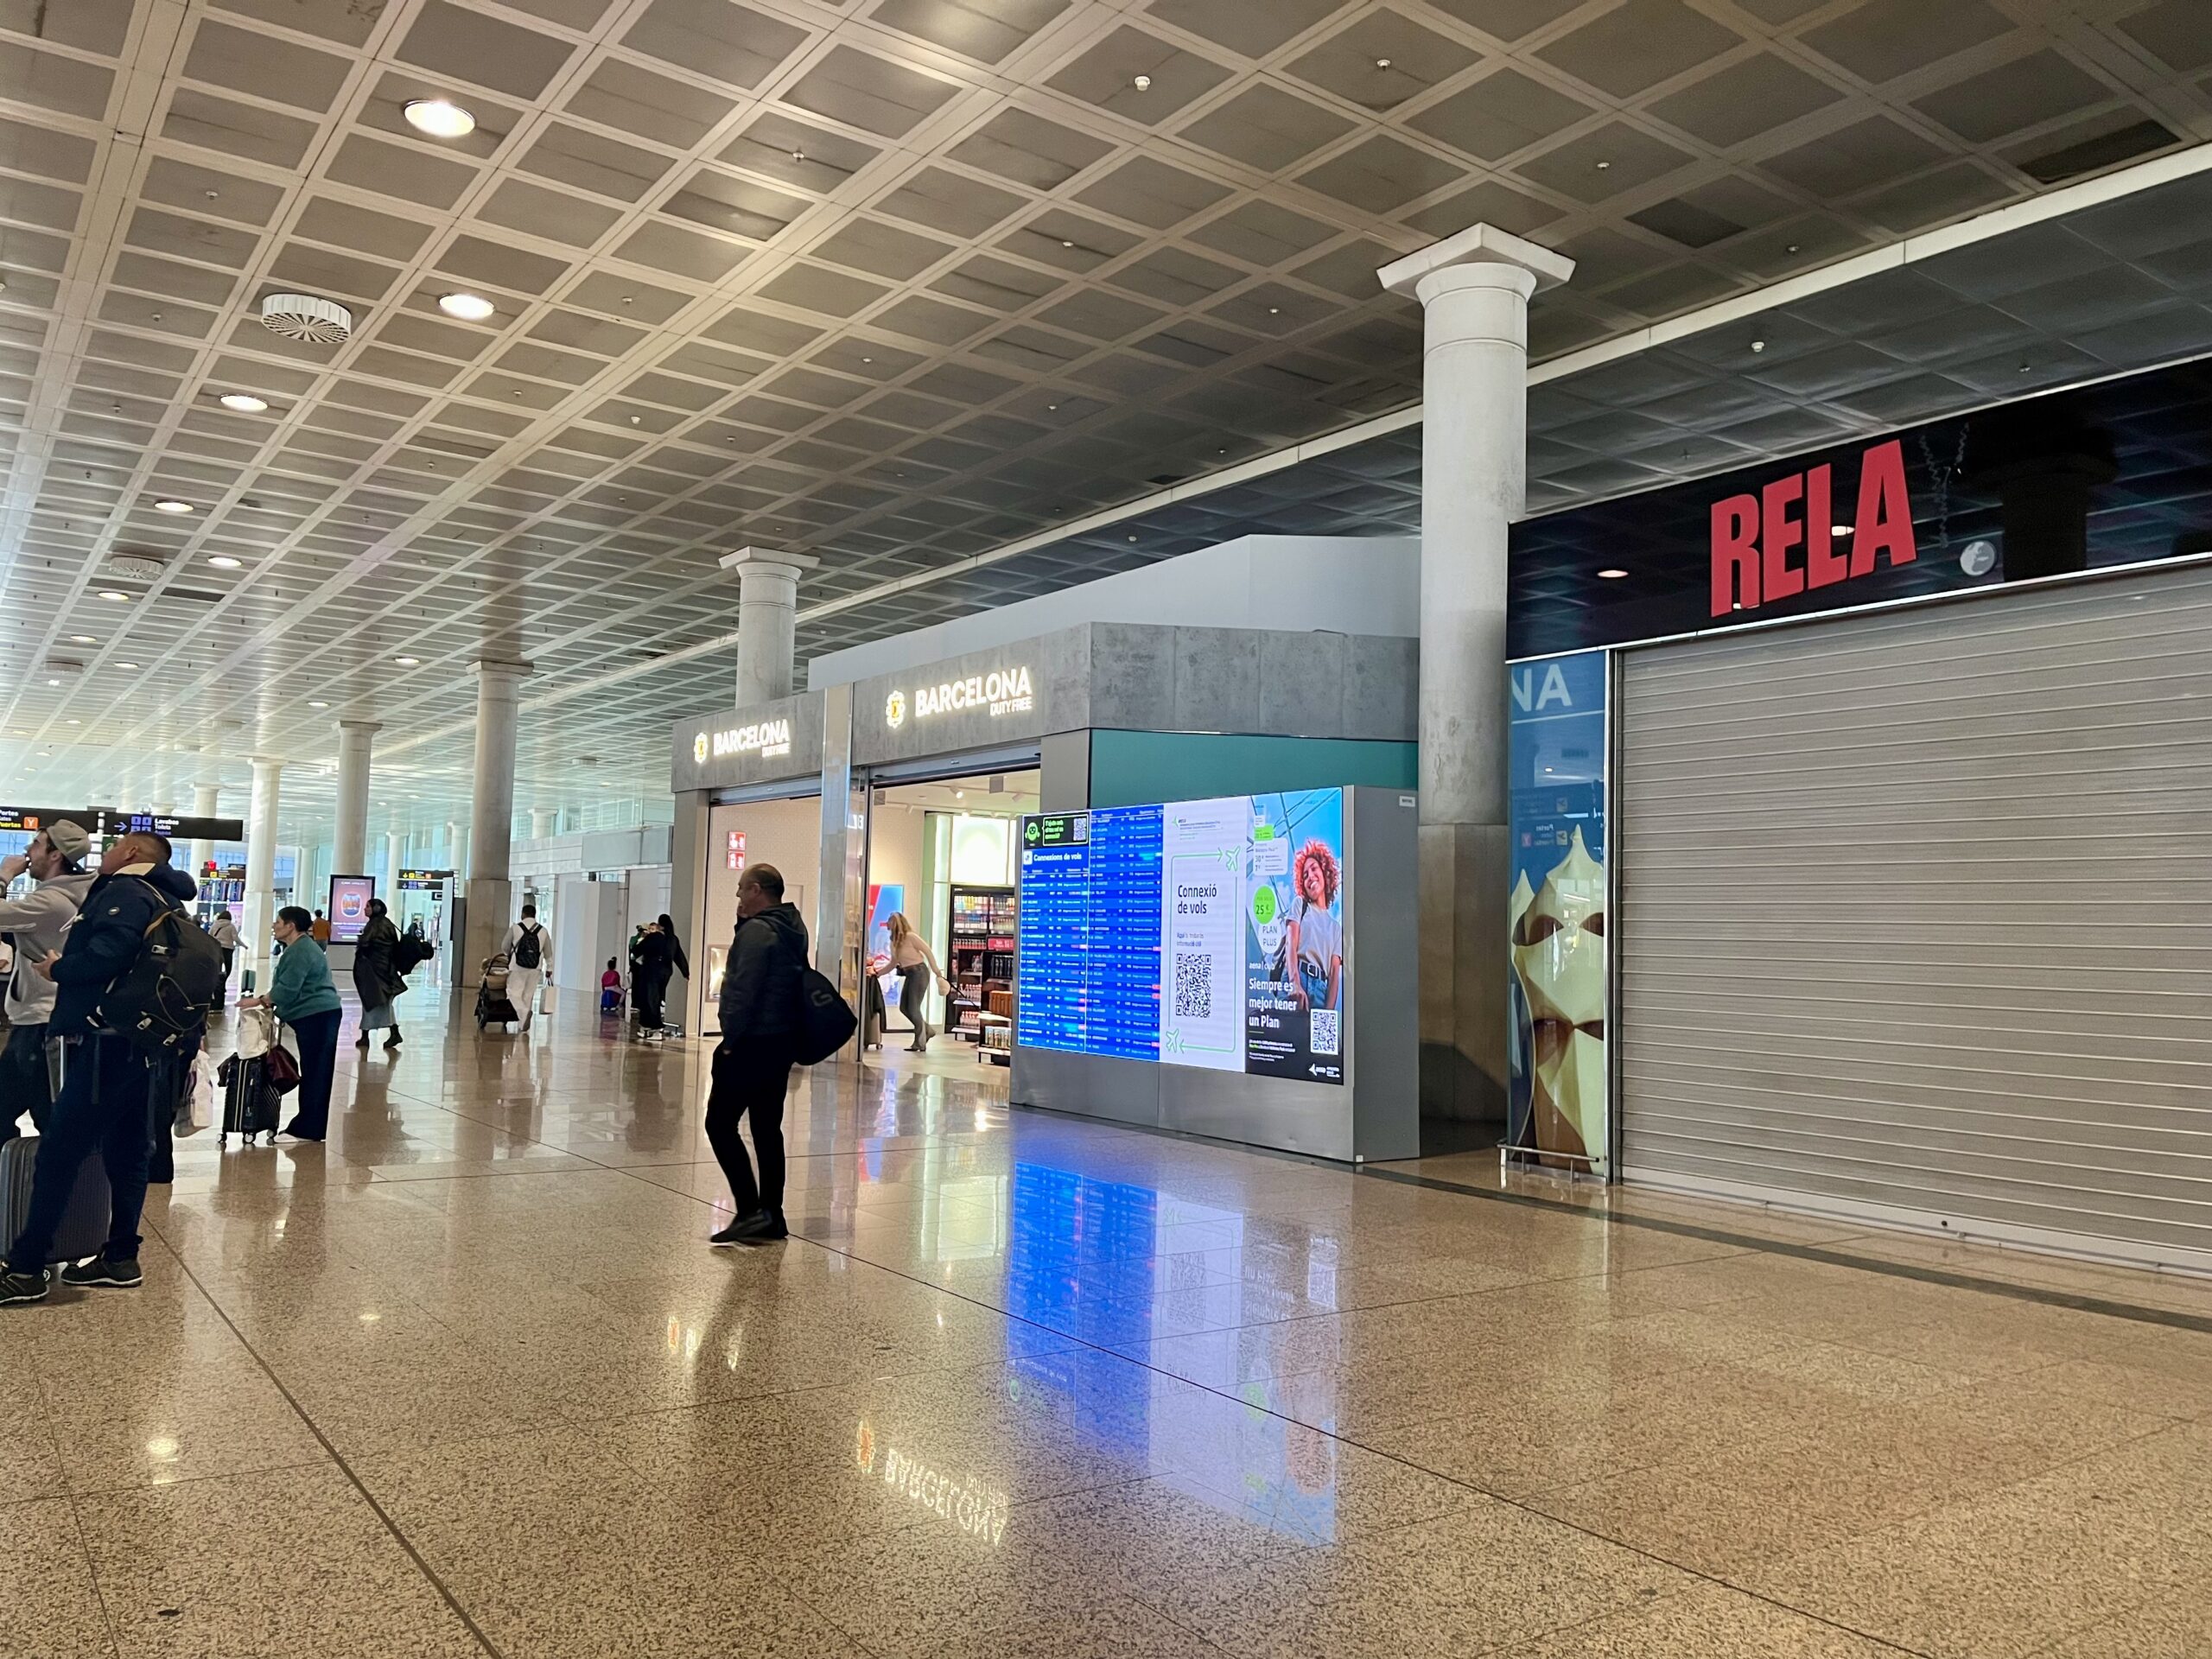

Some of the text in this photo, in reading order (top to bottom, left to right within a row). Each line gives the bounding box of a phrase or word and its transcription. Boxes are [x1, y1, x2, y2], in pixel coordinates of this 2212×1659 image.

[1711, 439, 1916, 618] RELA
[915, 666, 1033, 717] BARCELONA
[989, 696, 1033, 716] DUTY FREE
[714, 718, 790, 756] BARCELONA
[1033, 852, 1082, 861] Connexions de vols
[1178, 883, 1217, 898] Connexió
[1178, 900, 1207, 914] de vols
[1255, 905, 1264, 915] 25
[1262, 925, 1277, 934] PLAN
[1249, 977, 1294, 993] Siempre es
[1249, 996, 1297, 1012] mejor tener
[1249, 1014, 1280, 1028] un Plan
